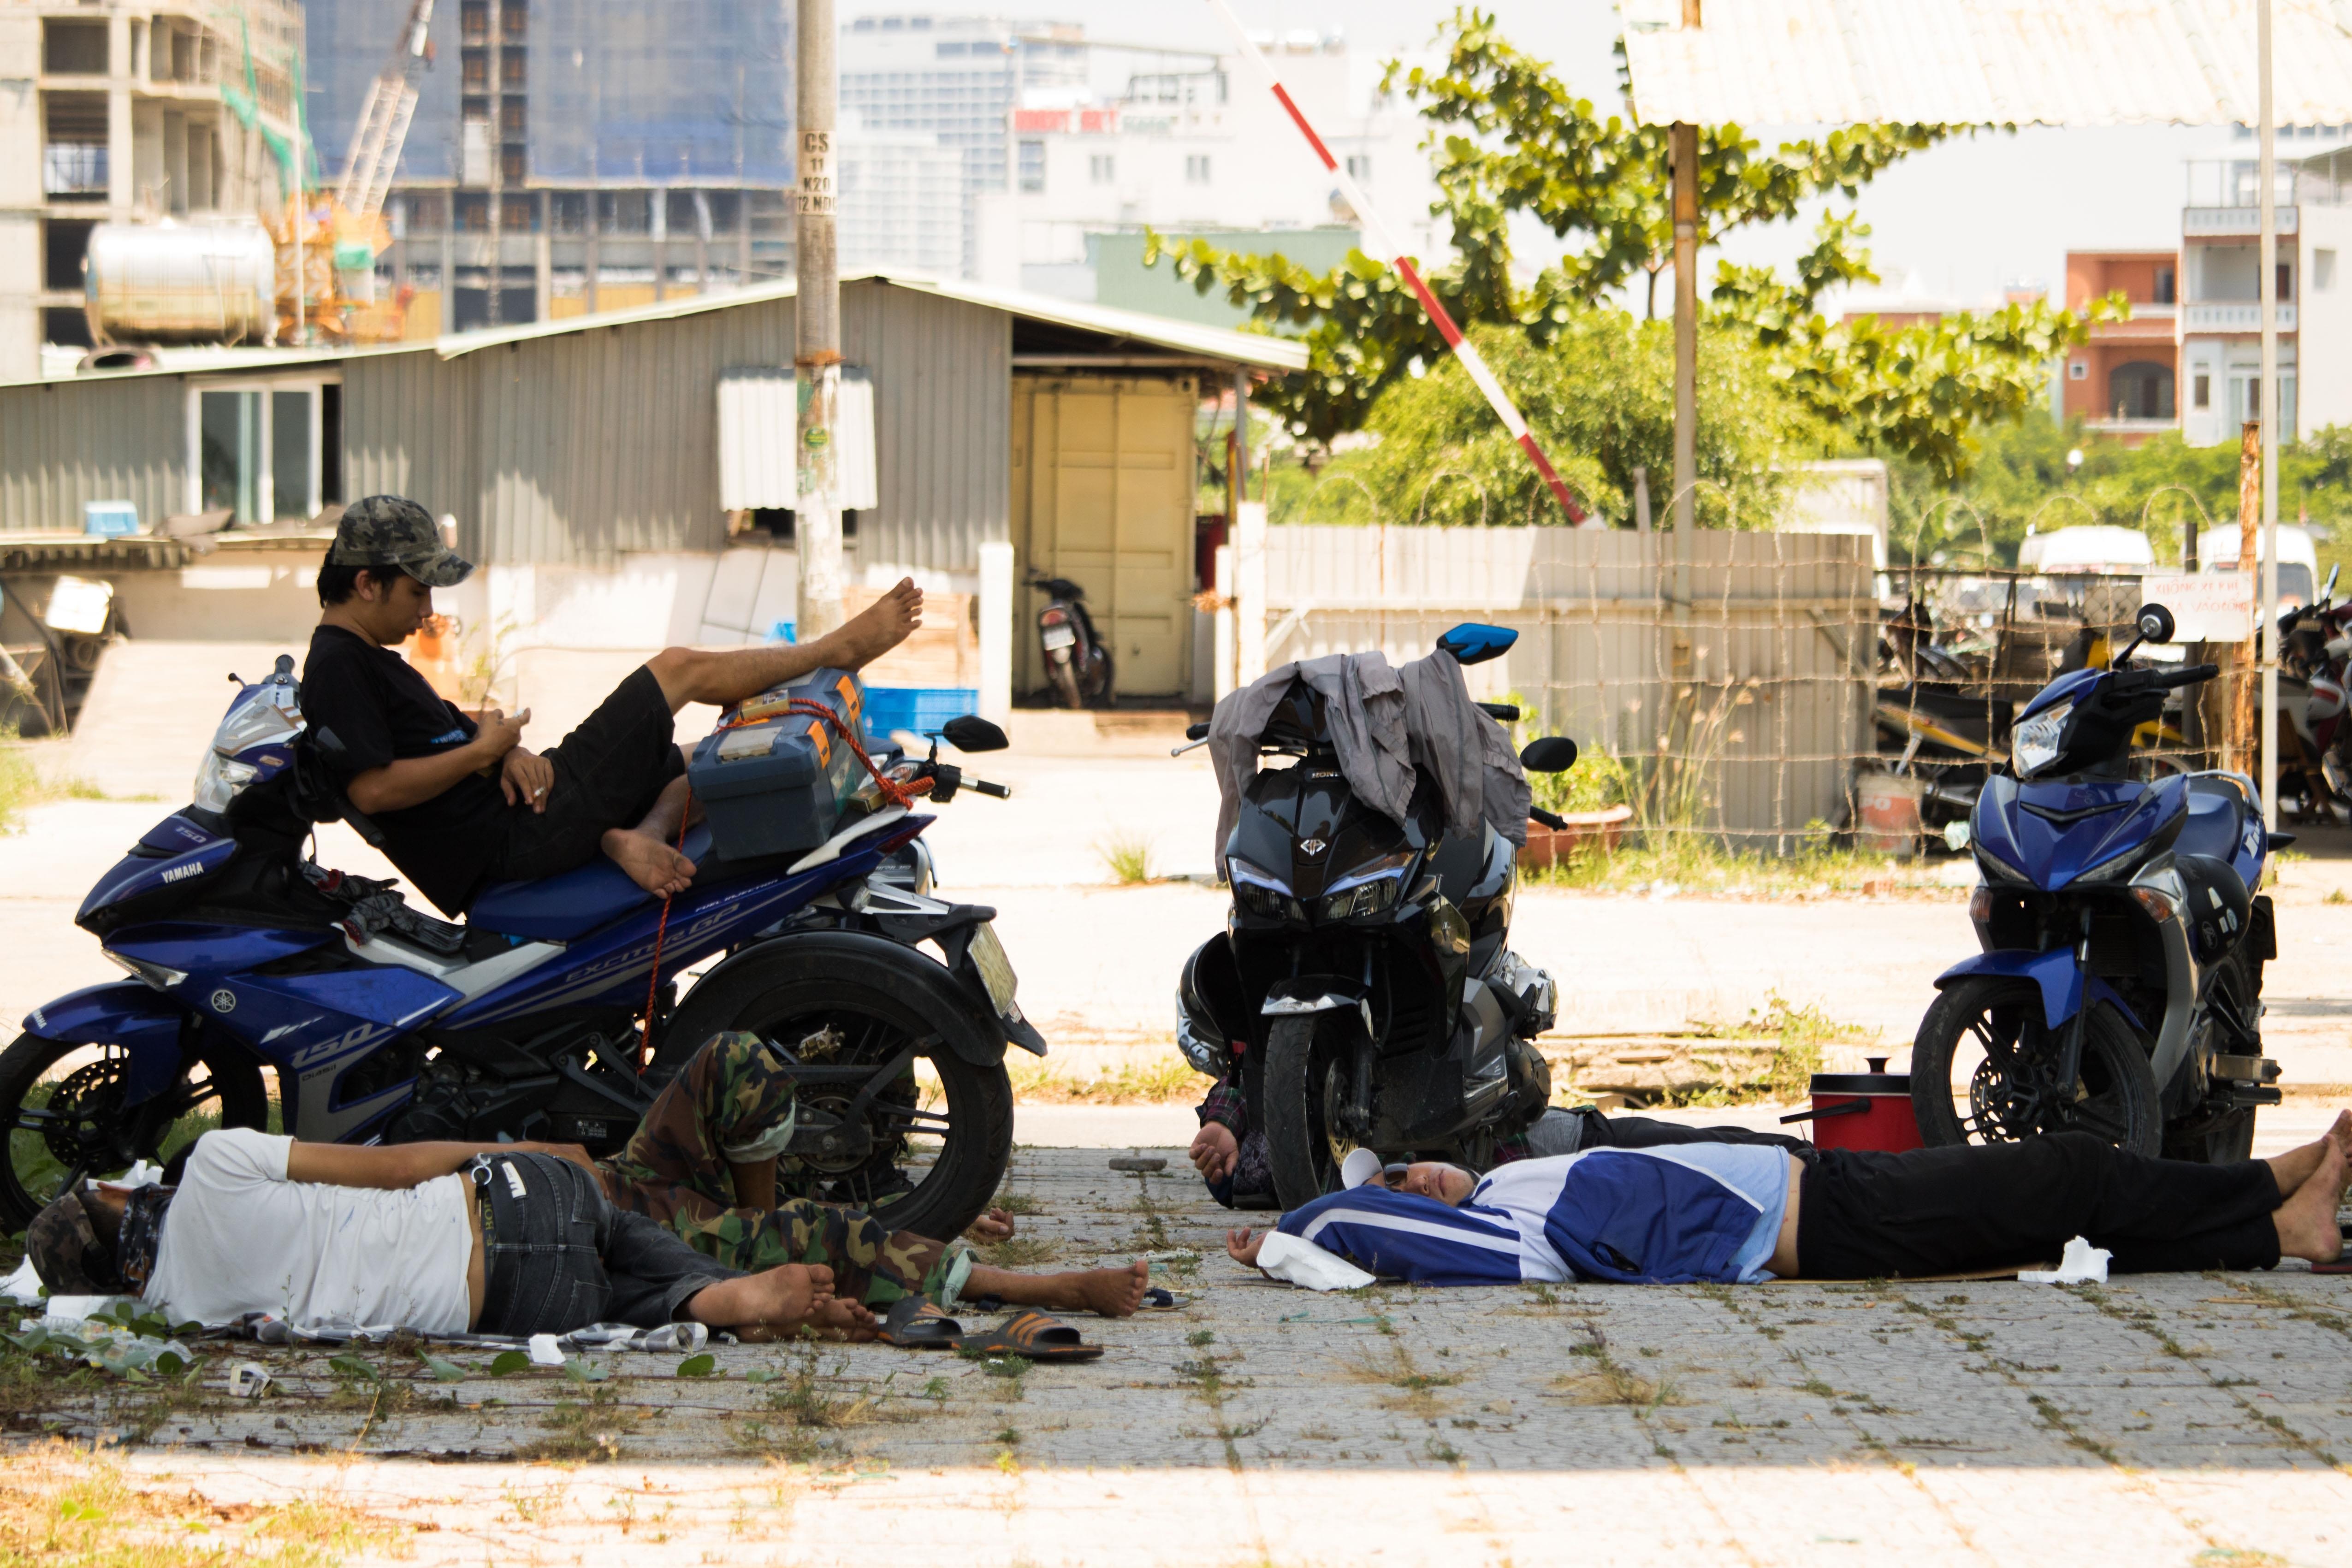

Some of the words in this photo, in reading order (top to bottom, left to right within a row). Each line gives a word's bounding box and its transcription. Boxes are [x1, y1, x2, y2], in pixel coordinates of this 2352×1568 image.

[805, 133, 828, 153] CS
[810, 158, 823, 172] 11
[804, 177, 830, 192] K20
[176, 826, 207, 843] 150
[161, 861, 204, 883] YAMAHA
[695, 900, 720, 912] FUEL
[724, 879, 778, 901] INJECTION
[565, 930, 686, 983] EXCITER
[688, 903, 740, 935] GP
[291, 1023, 373, 1070] 150
